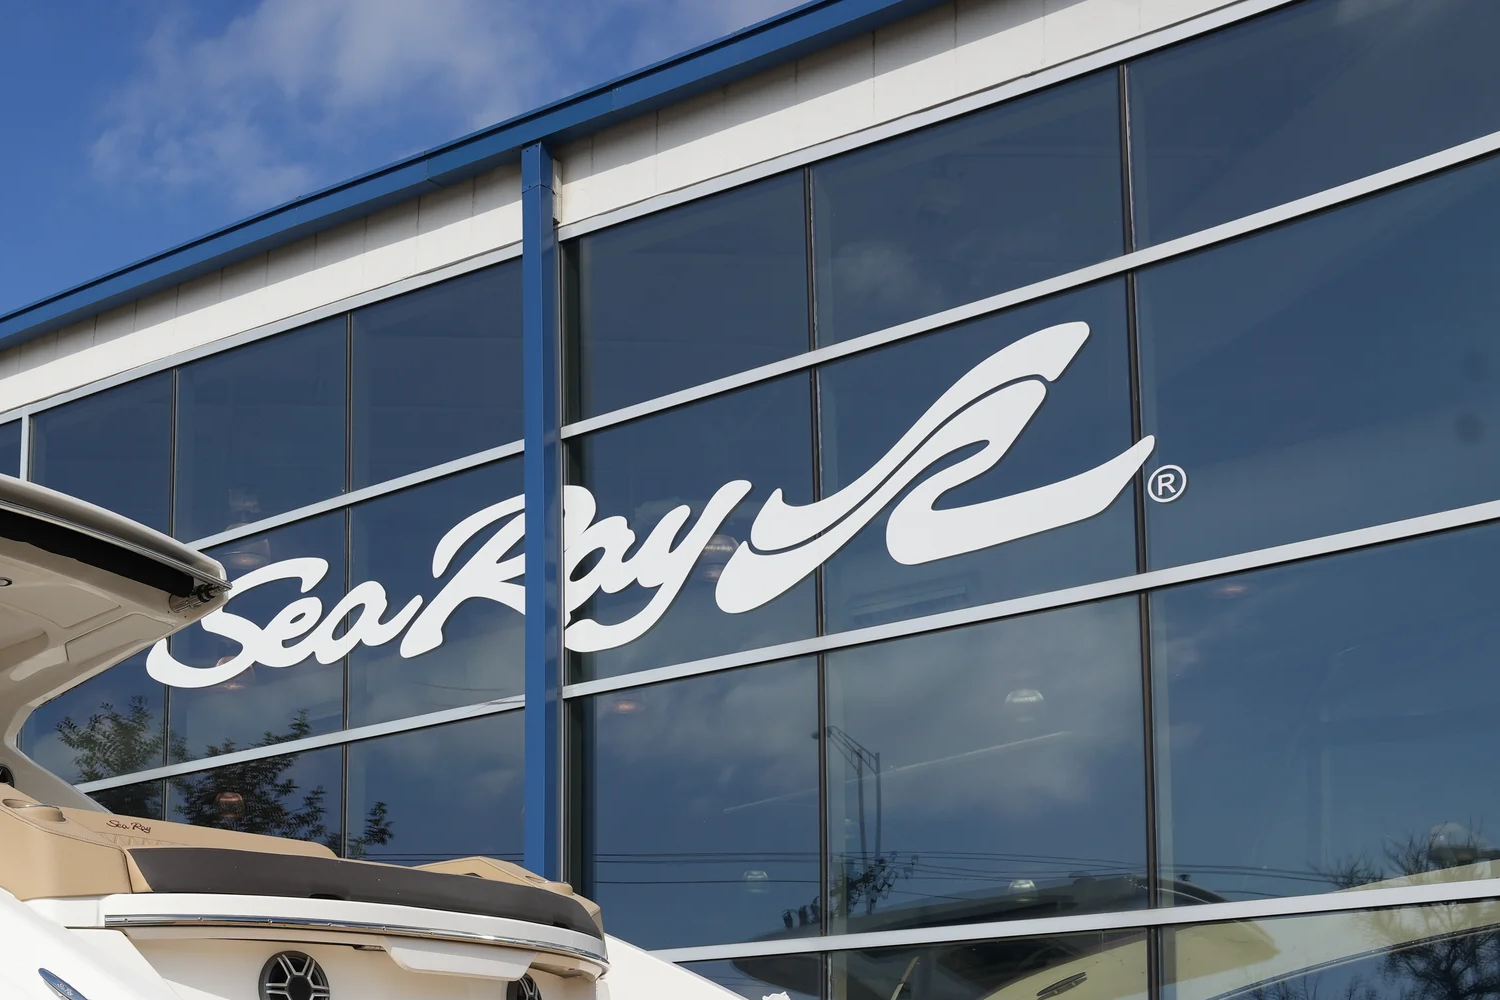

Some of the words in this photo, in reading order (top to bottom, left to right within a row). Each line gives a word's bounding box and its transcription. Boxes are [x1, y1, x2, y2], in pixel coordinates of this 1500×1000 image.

[146, 557, 423, 688] Sea
[400, 479, 752, 658] Ray
[106, 819, 130, 830] Sea
[130, 821, 152, 834] Ray
